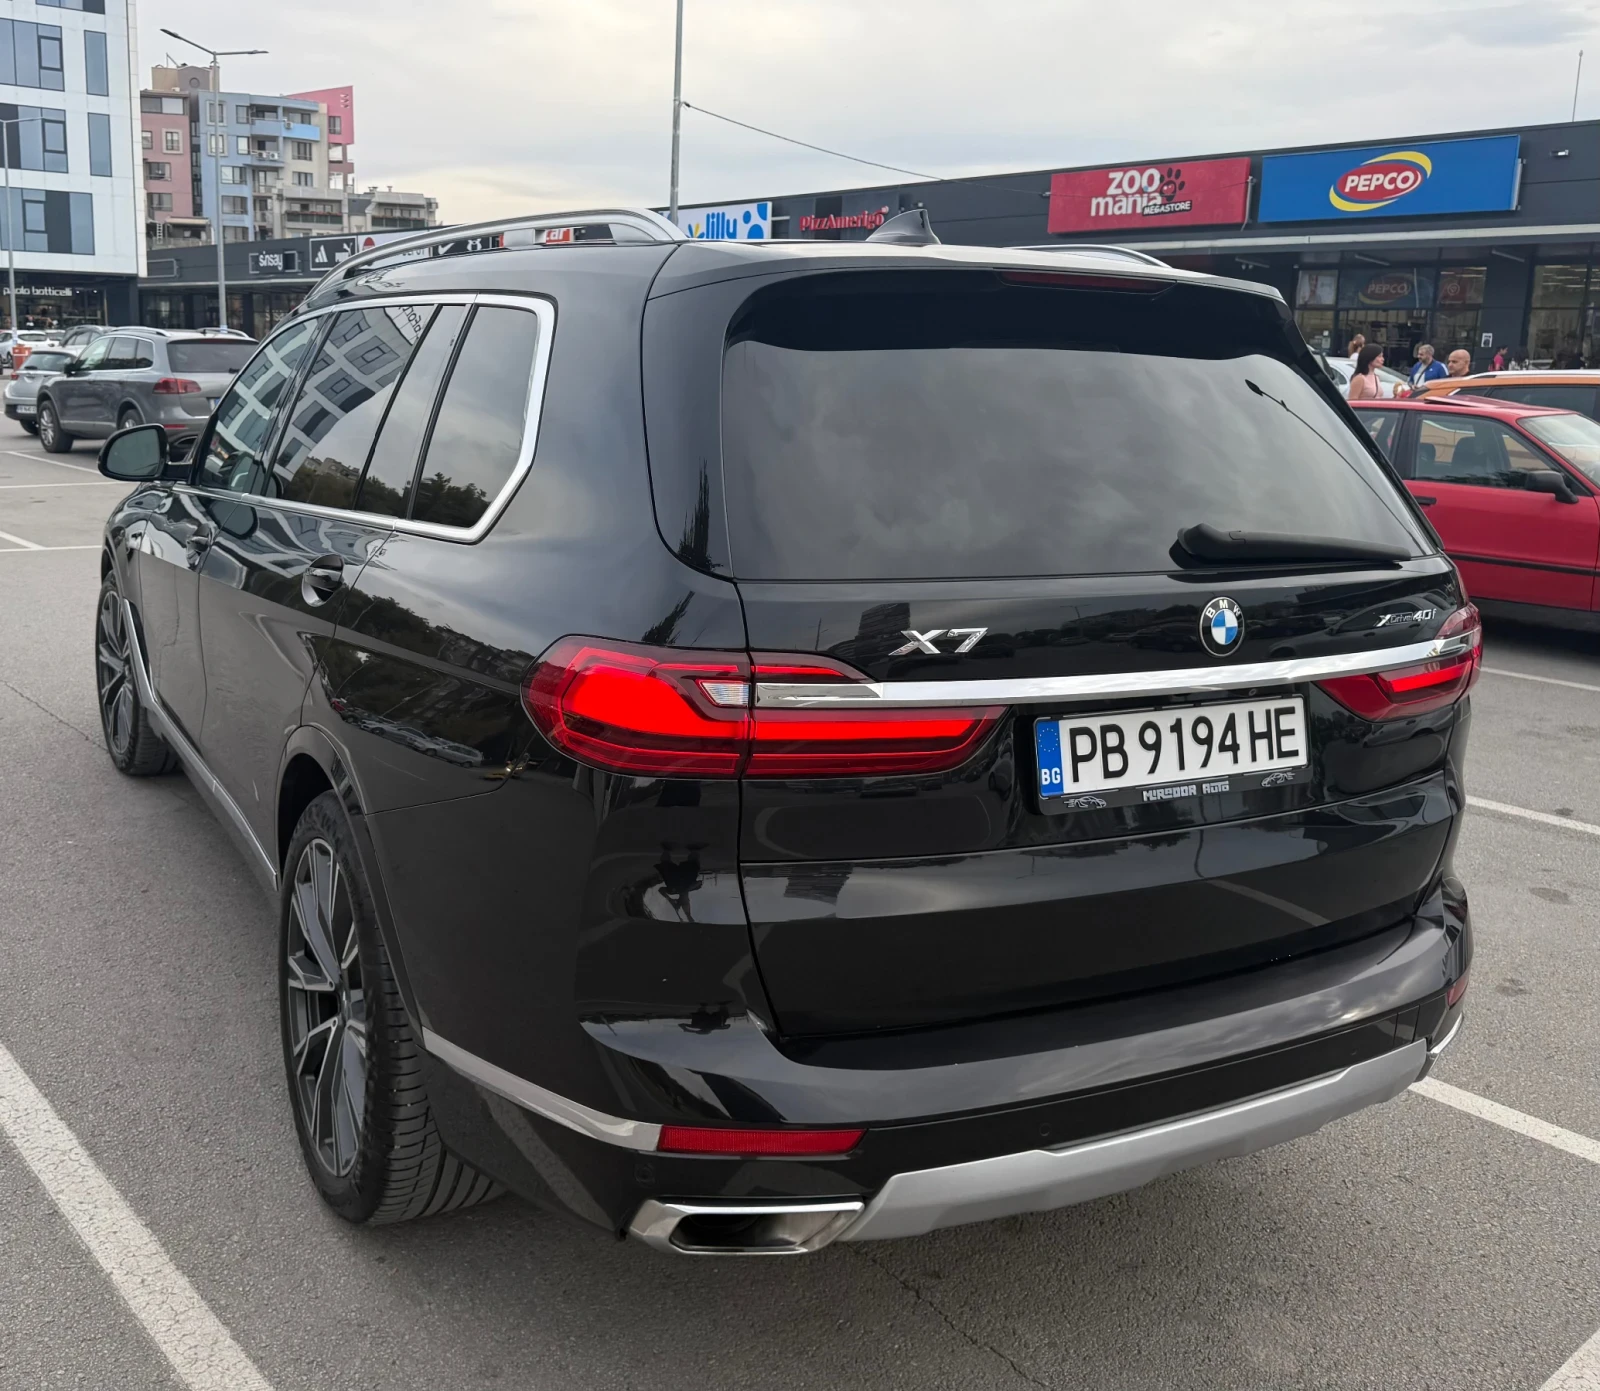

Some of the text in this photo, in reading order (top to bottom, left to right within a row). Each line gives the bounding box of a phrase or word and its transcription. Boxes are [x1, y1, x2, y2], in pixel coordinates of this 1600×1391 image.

[1344, 170, 1415, 192] PEPCO
[1143, 201, 1192, 216] MEGASTORE
[258, 250, 283, 271] sinsay
[31, 286, 73, 297] botticelli
[1367, 282, 1409, 295] PEPCO
[888, 627, 988, 656] X7
[1069, 706, 1299, 783] PB 9194 HE
[1041, 767, 1061, 785] BG
